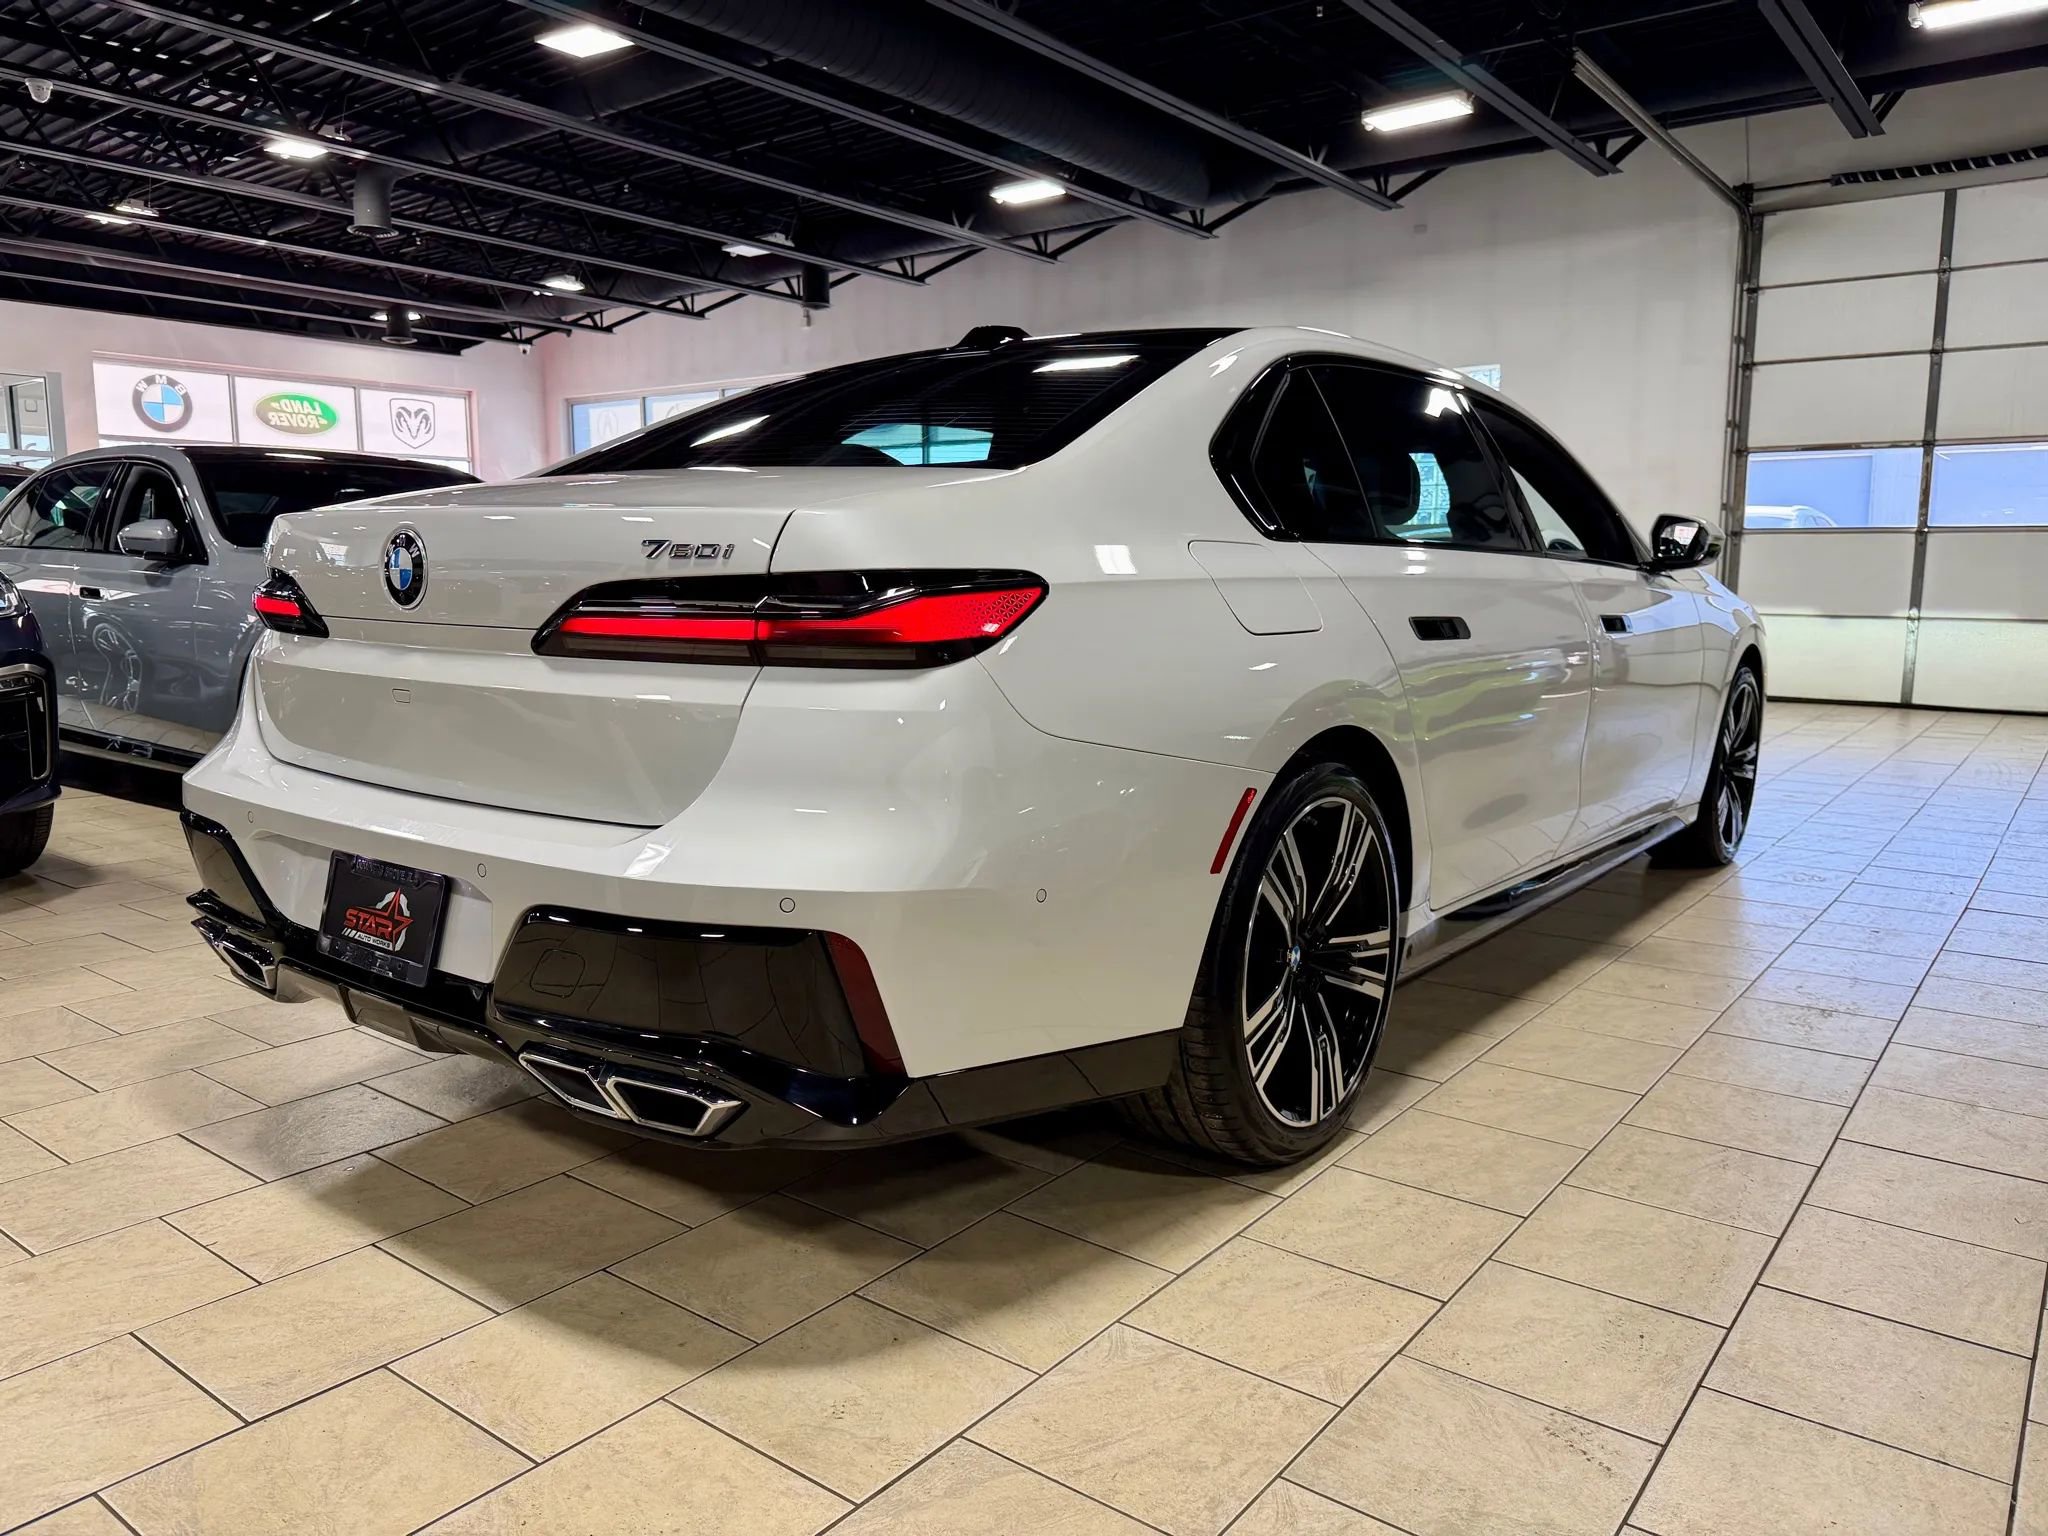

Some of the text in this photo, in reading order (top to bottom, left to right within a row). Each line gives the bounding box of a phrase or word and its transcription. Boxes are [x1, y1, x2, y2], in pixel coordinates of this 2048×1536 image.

[641, 539, 735, 559] 760i
[344, 908, 393, 939] STAR
[358, 933, 391, 949] AUTO WORKS
